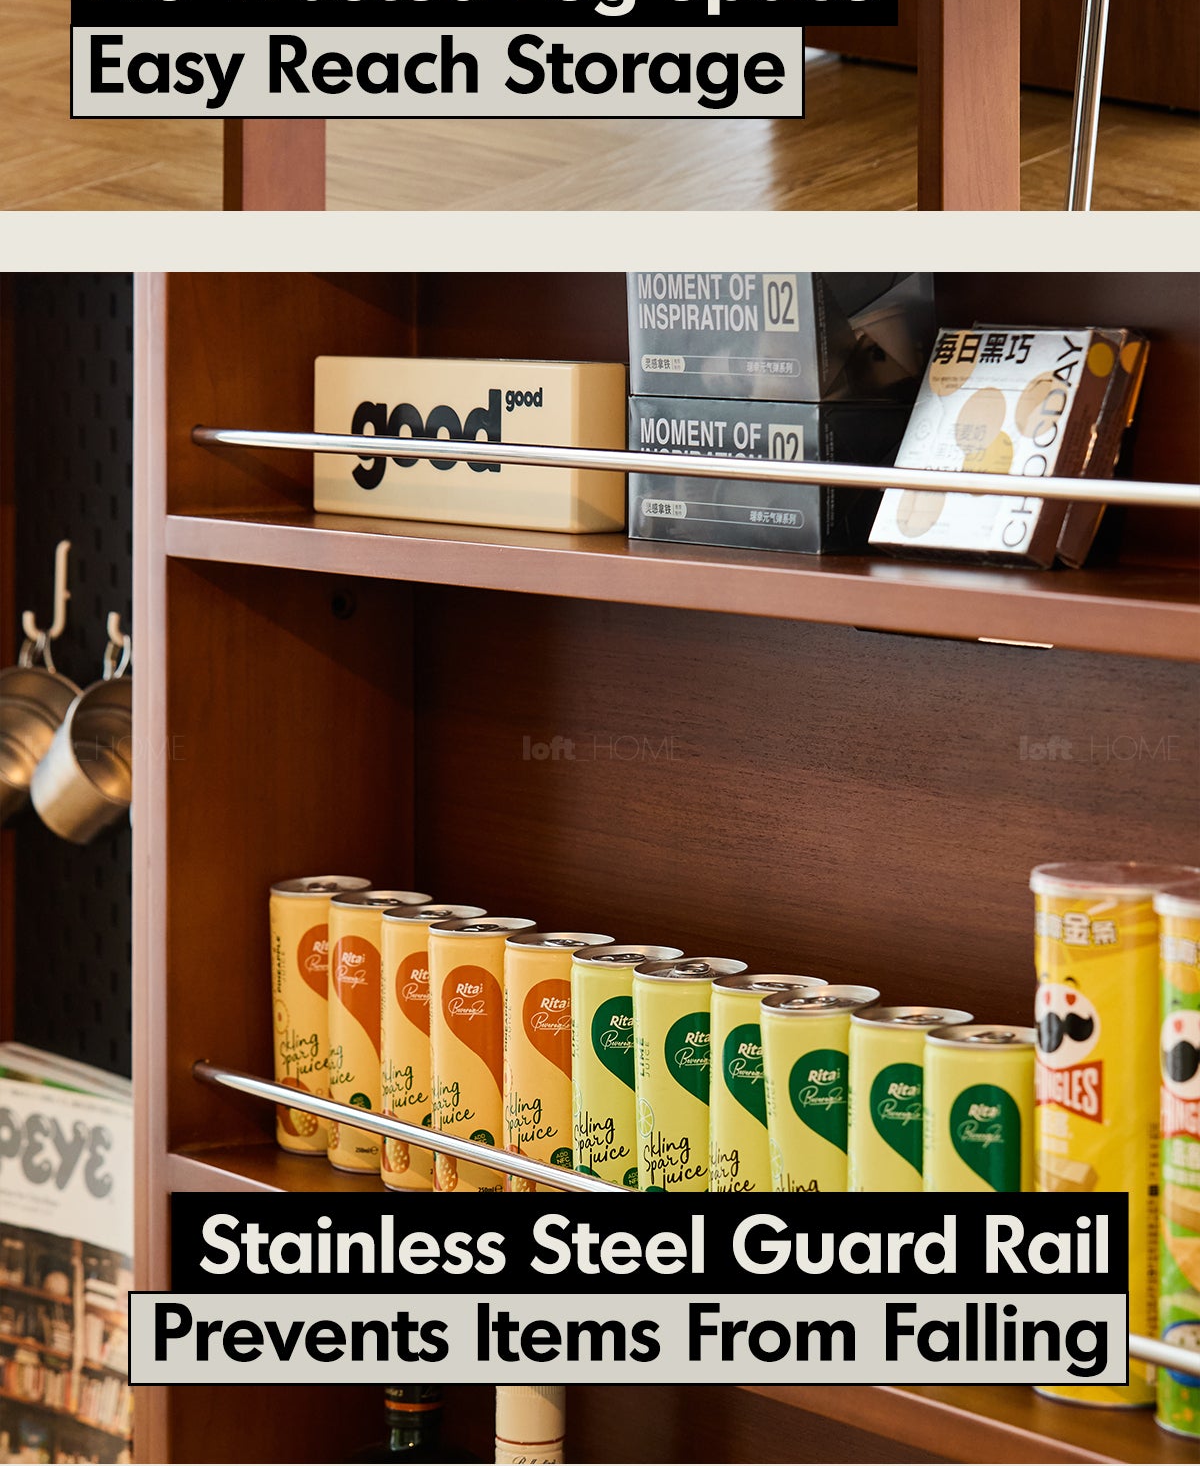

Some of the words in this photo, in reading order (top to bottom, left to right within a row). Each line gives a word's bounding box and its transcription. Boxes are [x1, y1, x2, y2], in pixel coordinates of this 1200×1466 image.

[637, 273, 722, 300] MOMENT
[729, 273, 756, 301] OF
[767, 281, 795, 325] 02
[639, 303, 758, 332] INSPIRATION
[932, 333, 1036, 365] 每日黑巧
[505, 387, 543, 412] good
[351, 388, 502, 490] good
[640, 417, 727, 448] MOMENT
[733, 422, 762, 450] OF
[773, 431, 799, 461] 02
[312, 941, 328, 953] Rit
[341, 952, 365, 966] Rita
[410, 969, 428, 980] Rit
[456, 982, 481, 997] Rita
[540, 997, 567, 1012] Rita
[610, 1015, 634, 1030] Rita
[685, 1031, 710, 1047] Rita
[738, 1042, 763, 1059] Rita
[296, 1058, 329, 1086] juice
[808, 1069, 839, 1085] Rita
[888, 1082, 919, 1100] Rita
[439, 1109, 476, 1130] juice
[968, 1103, 998, 1122] Rita
[579, 1111, 615, 1144] kling
[517, 1129, 559, 1154] juice
[650, 1131, 690, 1164] kling
[589, 1145, 630, 1175] juice
[643, 1144, 678, 1184] Spar
[662, 1162, 708, 1192] juice
